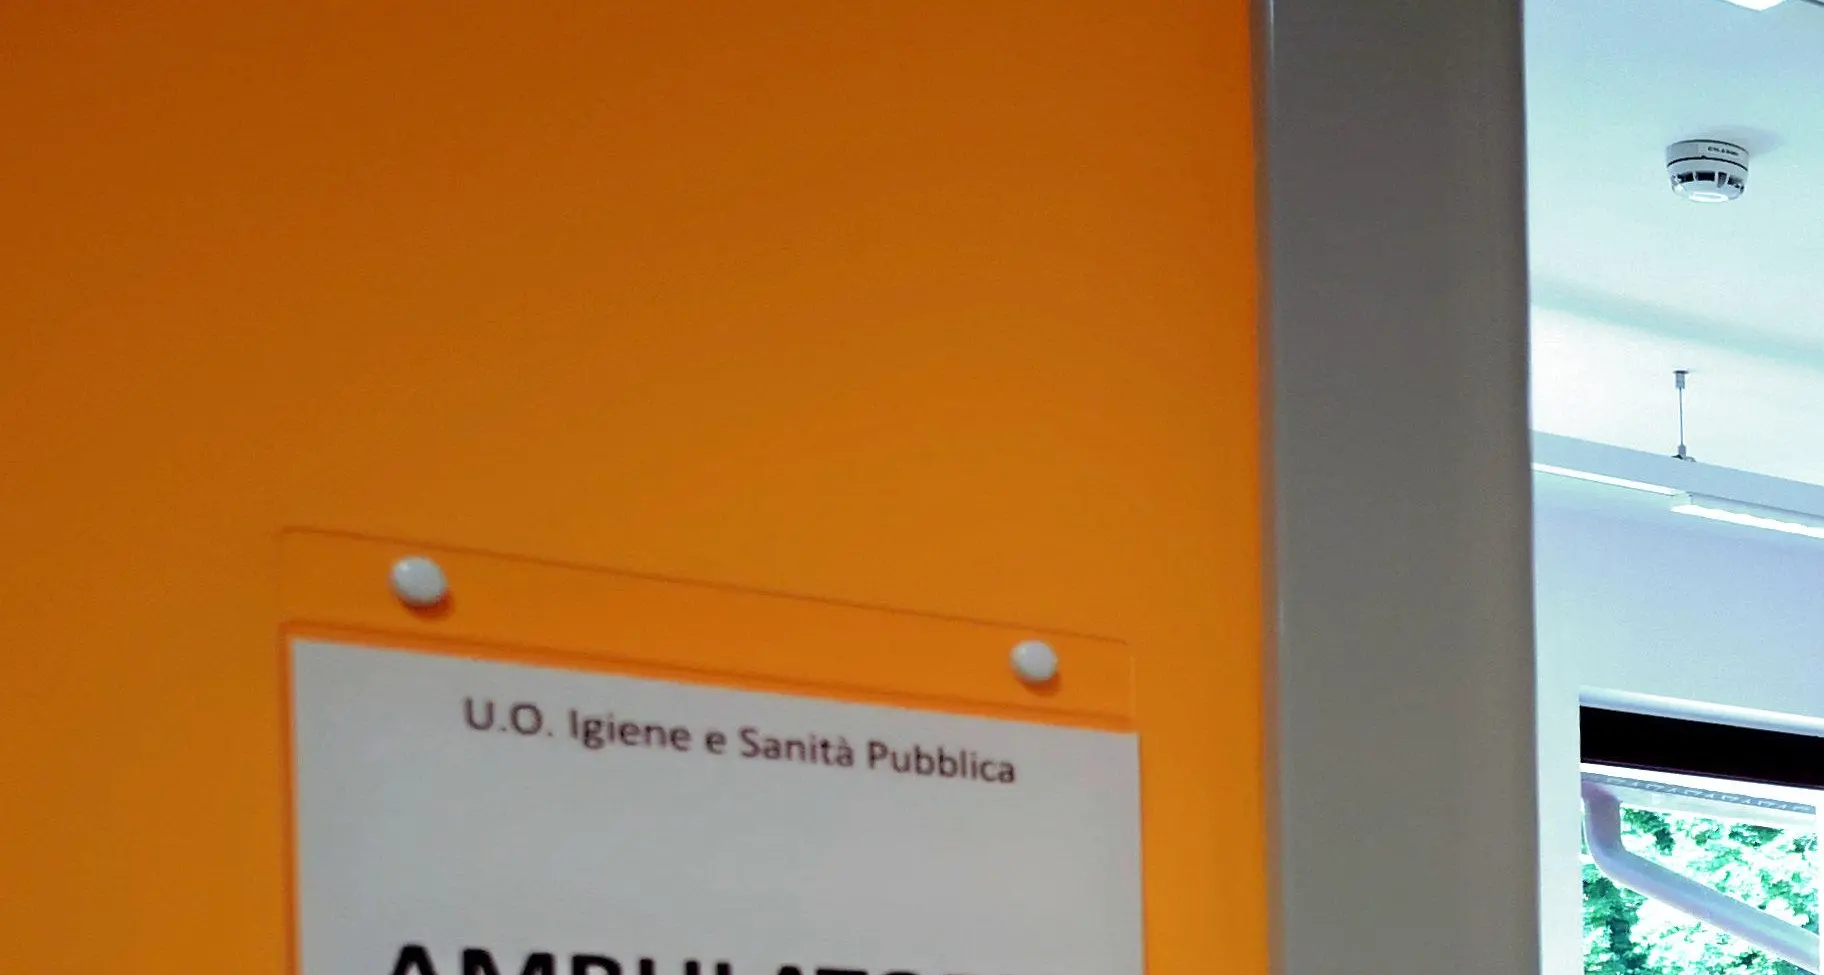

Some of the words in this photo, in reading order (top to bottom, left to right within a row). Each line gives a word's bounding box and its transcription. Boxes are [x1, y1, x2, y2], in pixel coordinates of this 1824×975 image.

[462, 695, 555, 738] U.O.
[567, 707, 693, 753] Igiene
[703, 729, 728, 756] e
[737, 725, 856, 769] Sanità
[865, 738, 1017, 785] Pubblica
